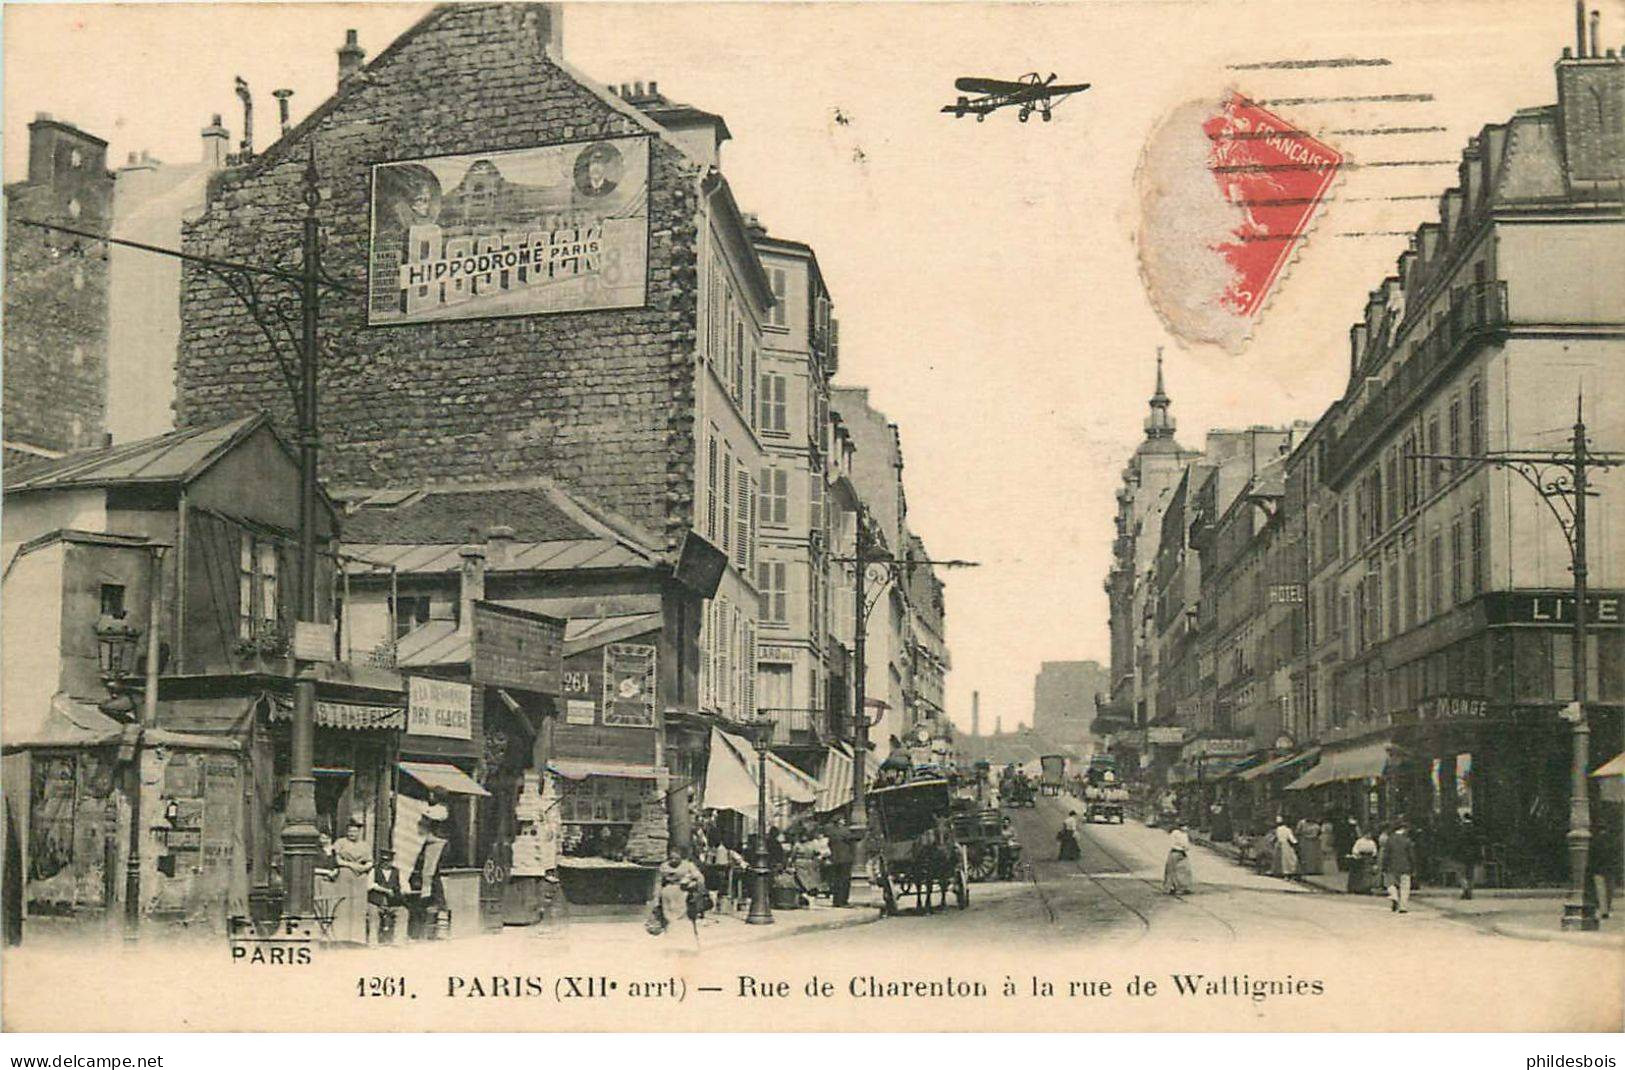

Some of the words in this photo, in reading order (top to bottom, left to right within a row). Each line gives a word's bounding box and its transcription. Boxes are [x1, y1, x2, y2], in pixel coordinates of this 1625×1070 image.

[409, 248, 544, 285] HIPPODROME
[550, 241, 599, 258] PARIS
[1269, 585, 1303, 602] HOTEL
[564, 672, 589, 693] 264
